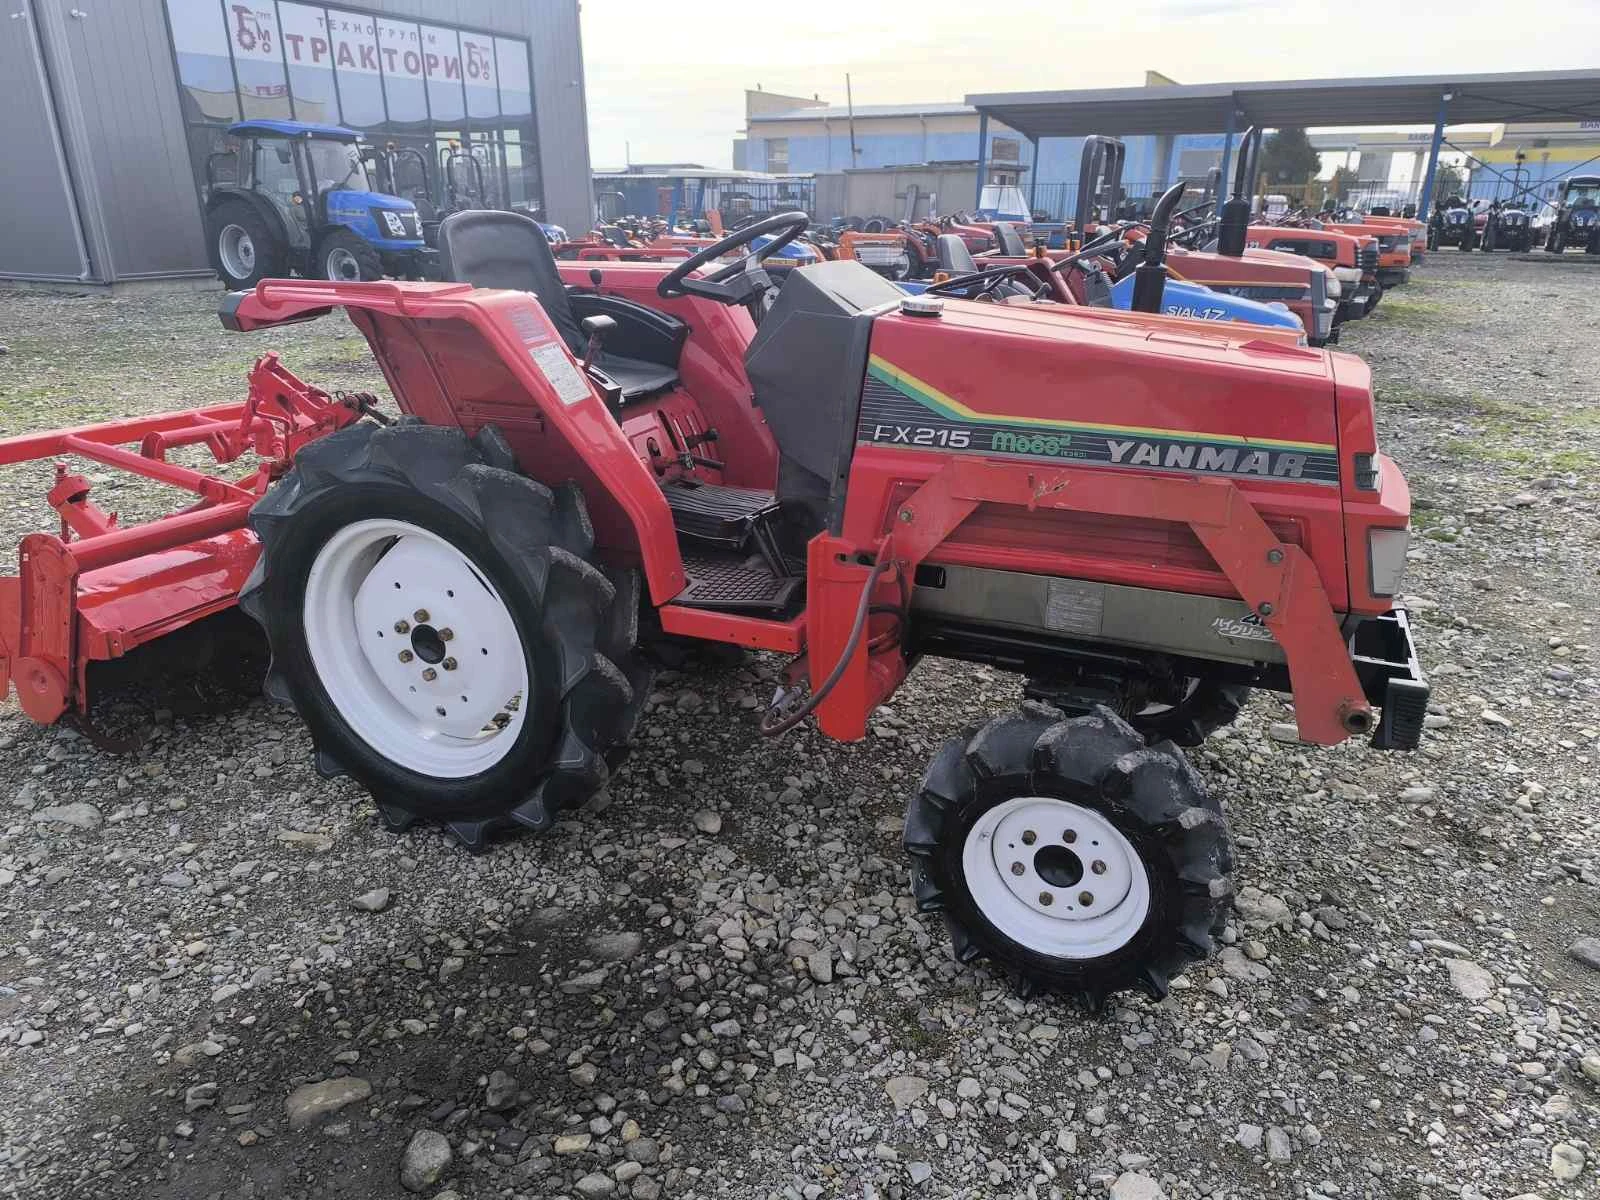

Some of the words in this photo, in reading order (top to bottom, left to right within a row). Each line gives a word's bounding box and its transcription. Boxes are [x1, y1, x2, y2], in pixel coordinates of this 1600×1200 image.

[285, 33, 460, 80] ТРАКТОРИ
[1167, 305, 1202, 320] SIAL
[1201, 308, 1226, 321] 17
[873, 425, 971, 448] FX215
[1106, 440, 1307, 478] YANMAR
